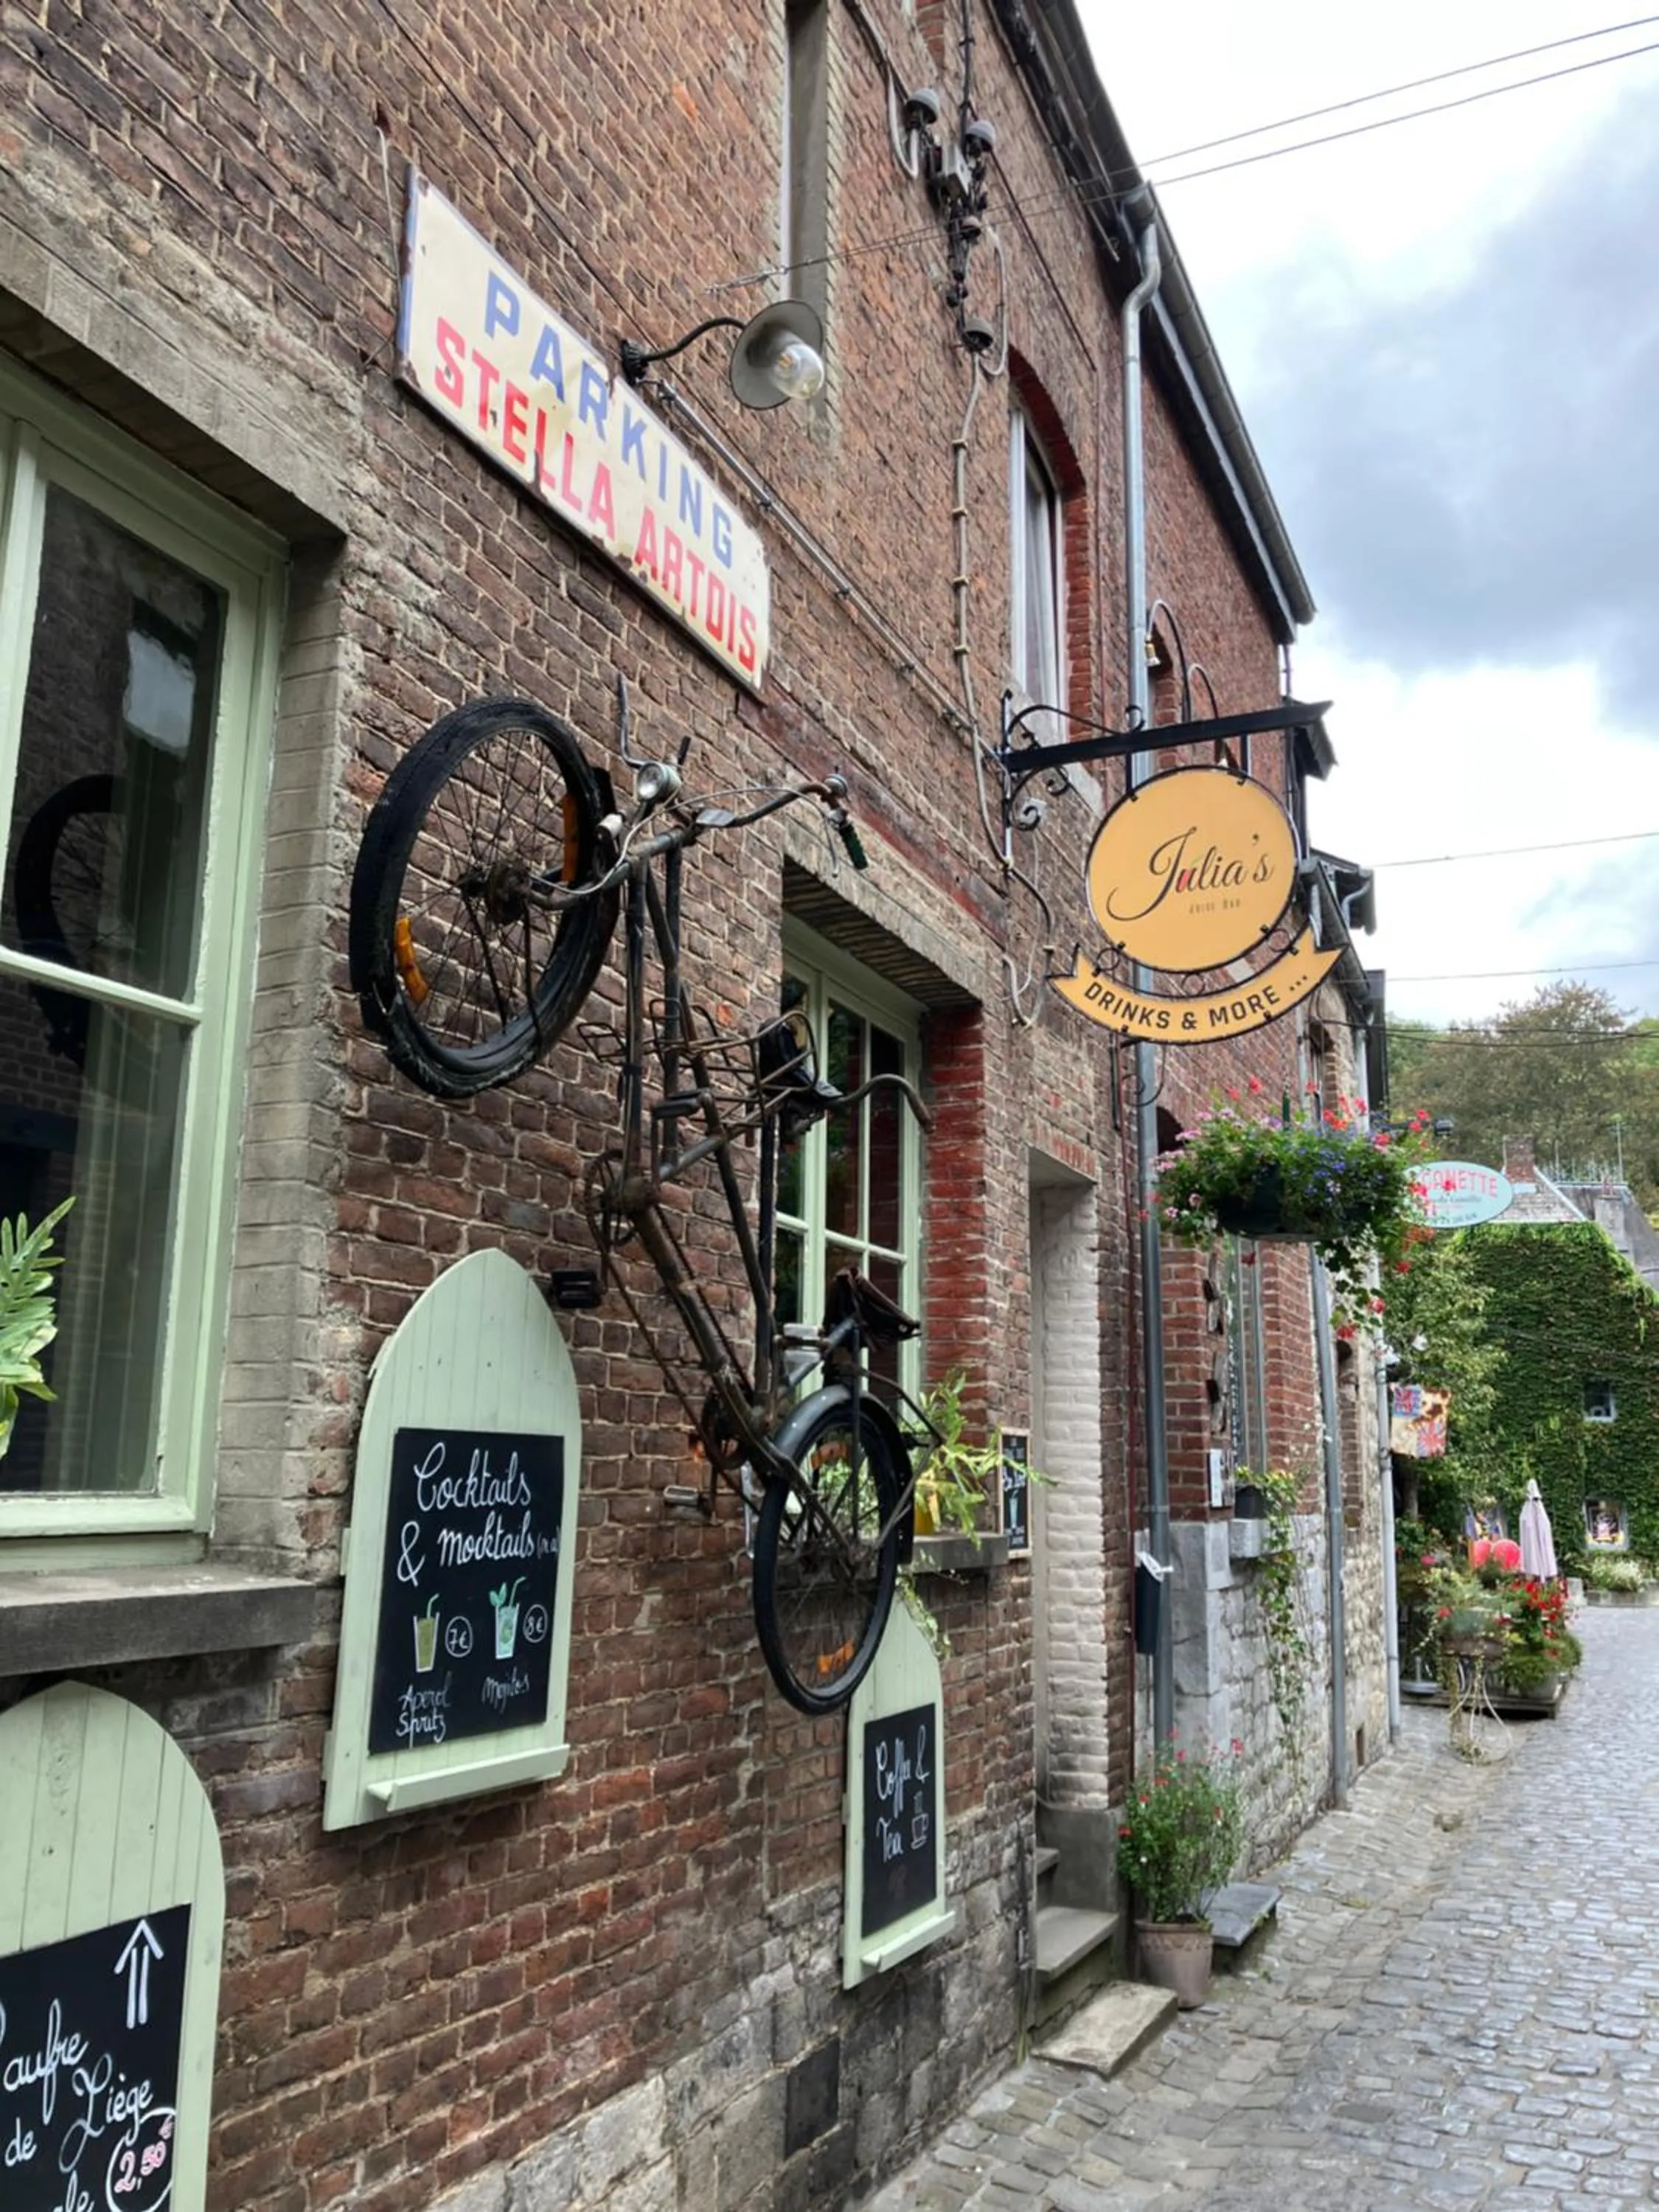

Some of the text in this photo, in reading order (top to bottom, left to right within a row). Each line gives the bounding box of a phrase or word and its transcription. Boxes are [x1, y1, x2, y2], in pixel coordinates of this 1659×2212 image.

[484, 270, 733, 568] PARKING
[434, 317, 757, 672] STELLA ARTOIS
[1107, 826, 1274, 922] Julia's
[1084, 981, 1170, 1029] DRINKS
[1181, 1012, 1197, 1031] &
[1209, 985, 1281, 1028] MORE
[414, 1441, 532, 1512] Cocktails
[396, 1520, 426, 1587] &
[876, 1816, 904, 1863] Tea
[0, 1998, 89, 2126] aufre
[4, 2116, 38, 2167] de
